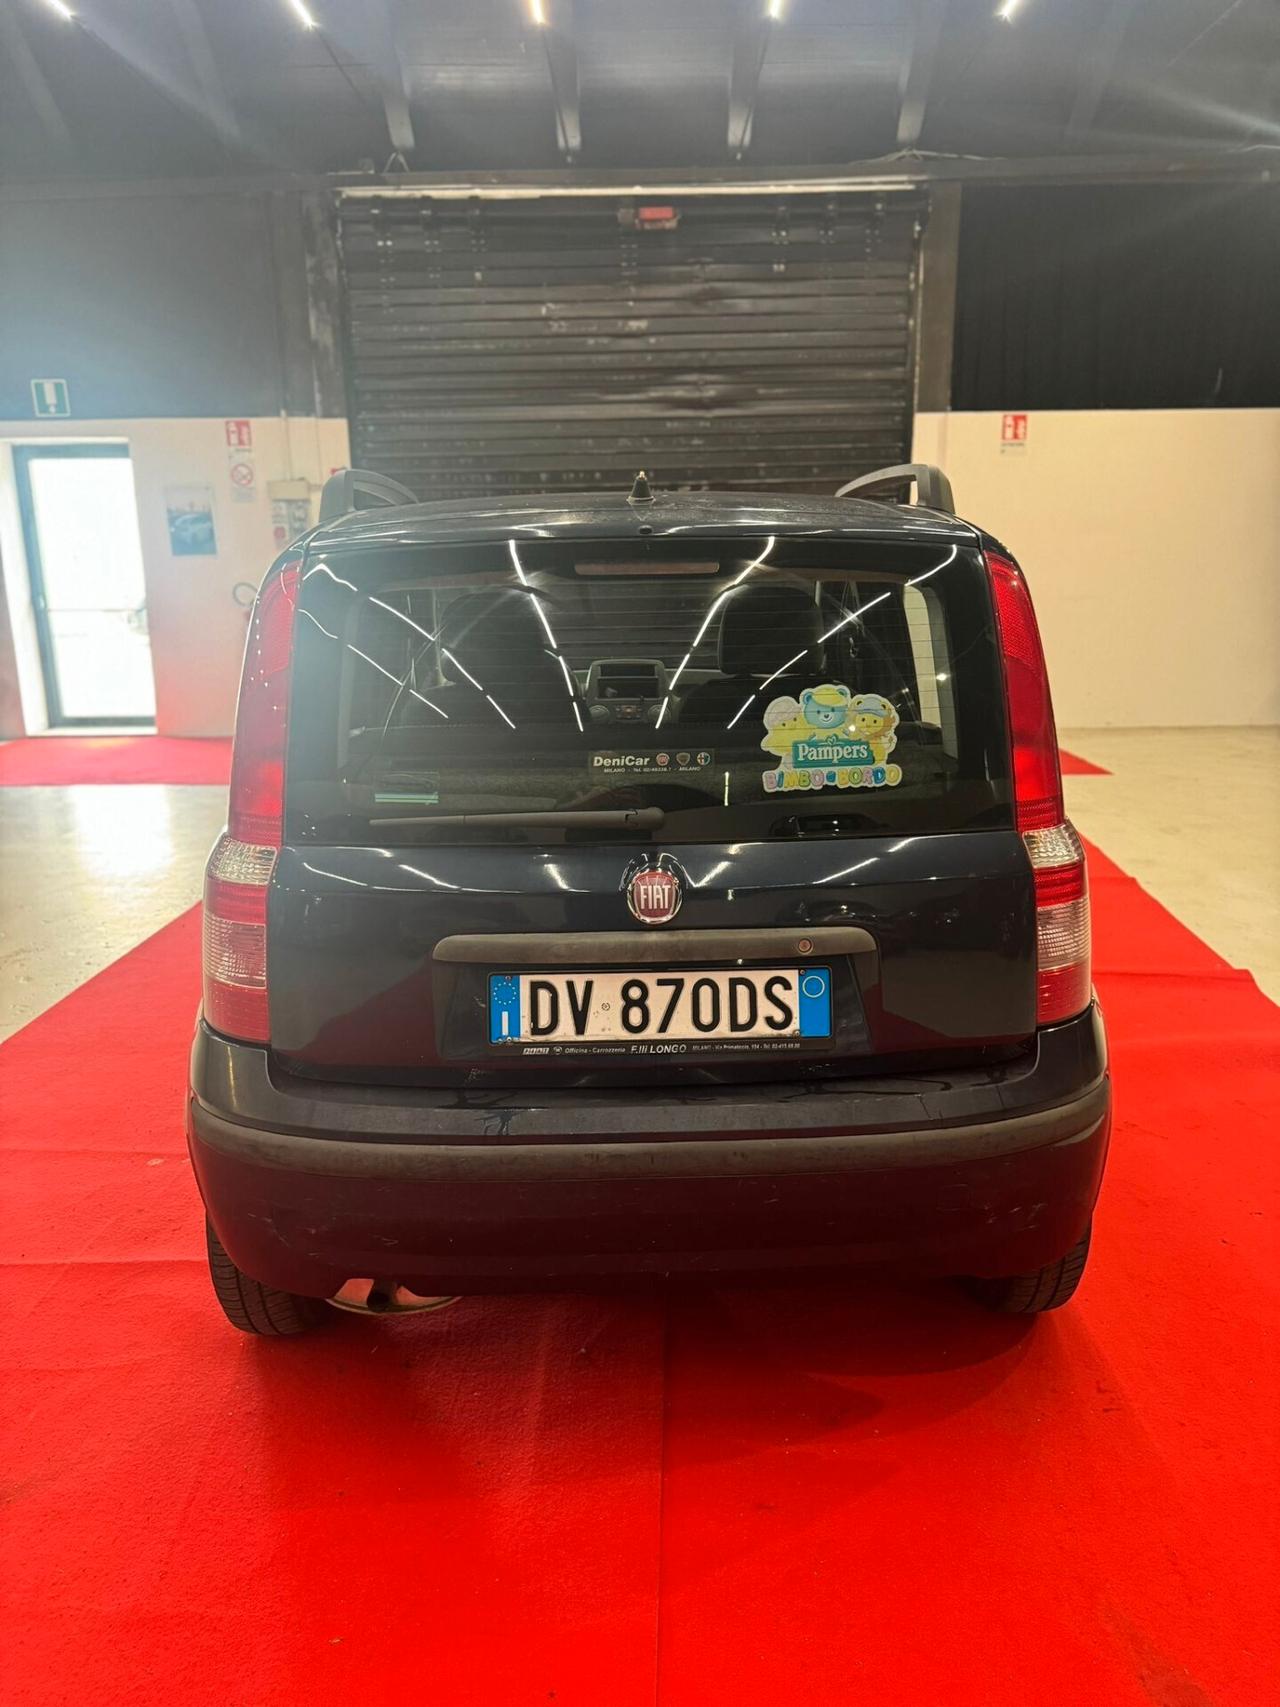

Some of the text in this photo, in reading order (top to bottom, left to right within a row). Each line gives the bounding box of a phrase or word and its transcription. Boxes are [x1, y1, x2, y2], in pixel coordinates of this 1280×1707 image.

[593, 756, 651, 767] DeniCar
[796, 743, 868, 764] Pampers
[837, 766, 900, 786] BORDO
[640, 884, 671, 910] FIAT
[529, 976, 794, 1036] DV 870DS
[649, 1044, 687, 1054] LONGO
